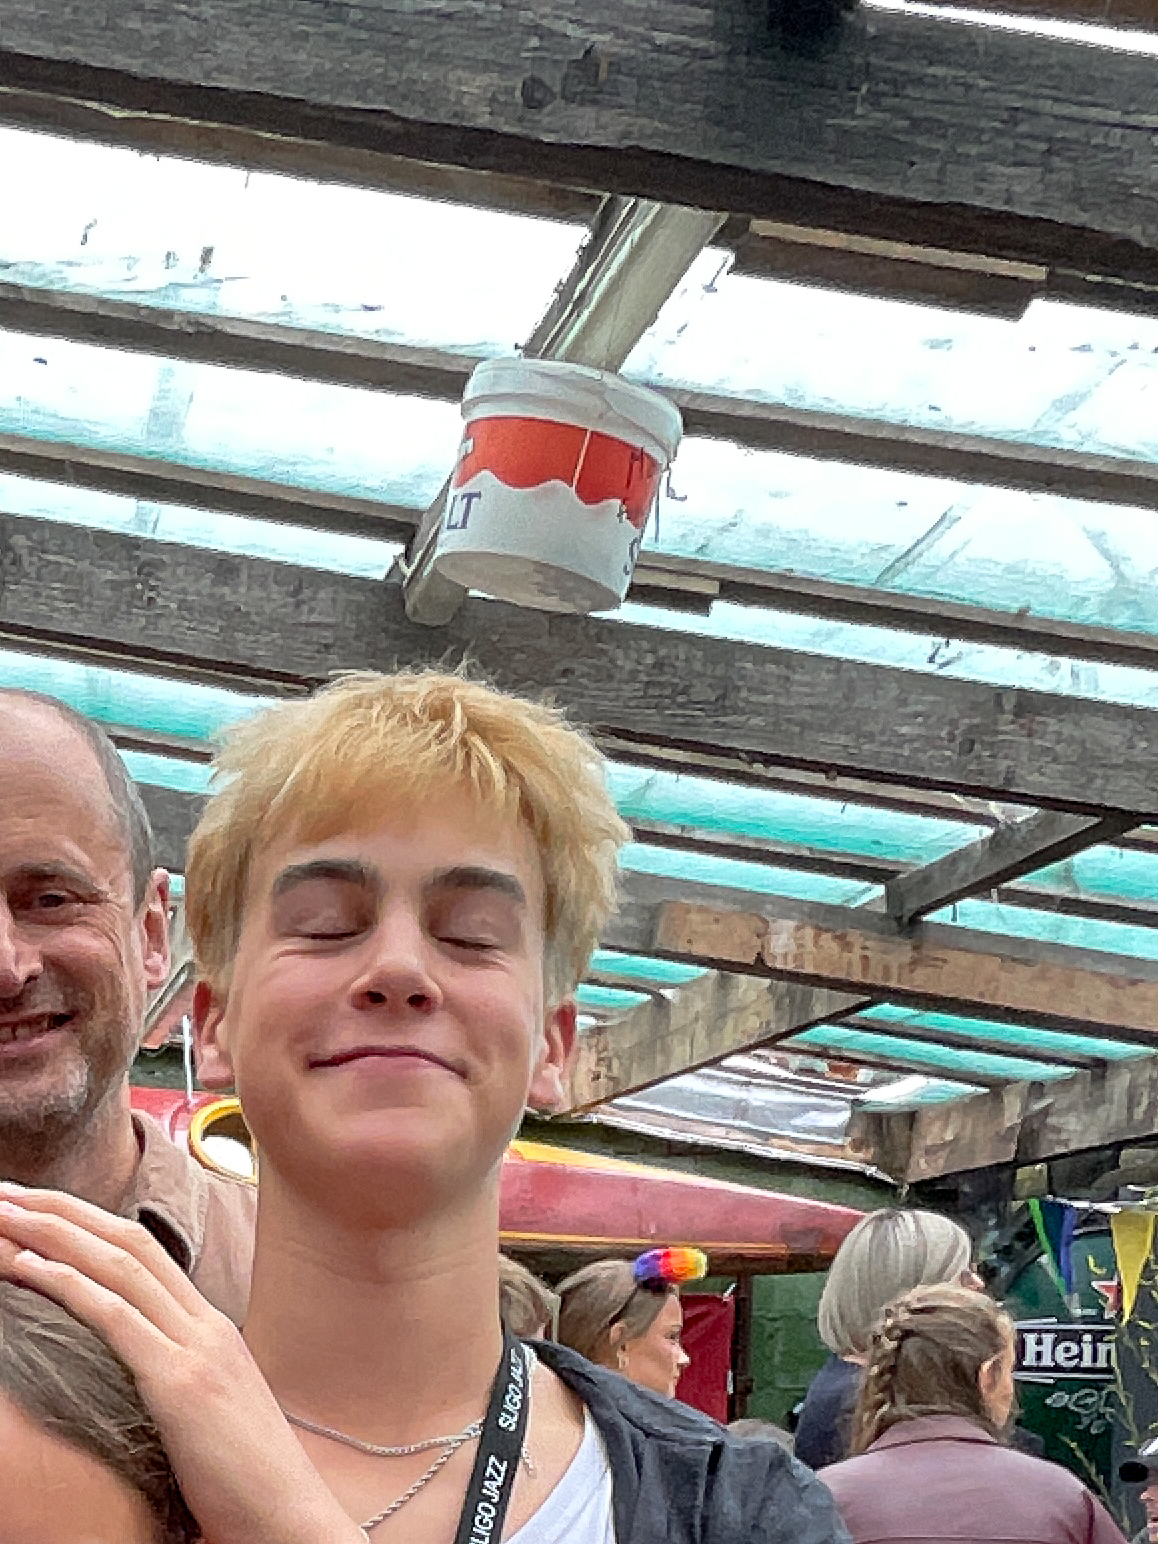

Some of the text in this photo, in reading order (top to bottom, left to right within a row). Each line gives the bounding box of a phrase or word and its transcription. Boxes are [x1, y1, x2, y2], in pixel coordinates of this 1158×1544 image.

[1022, 1332, 1116, 1368] Hein
[498, 1382, 524, 1432] SLIGO
[480, 1454, 509, 1503] JAZZ
